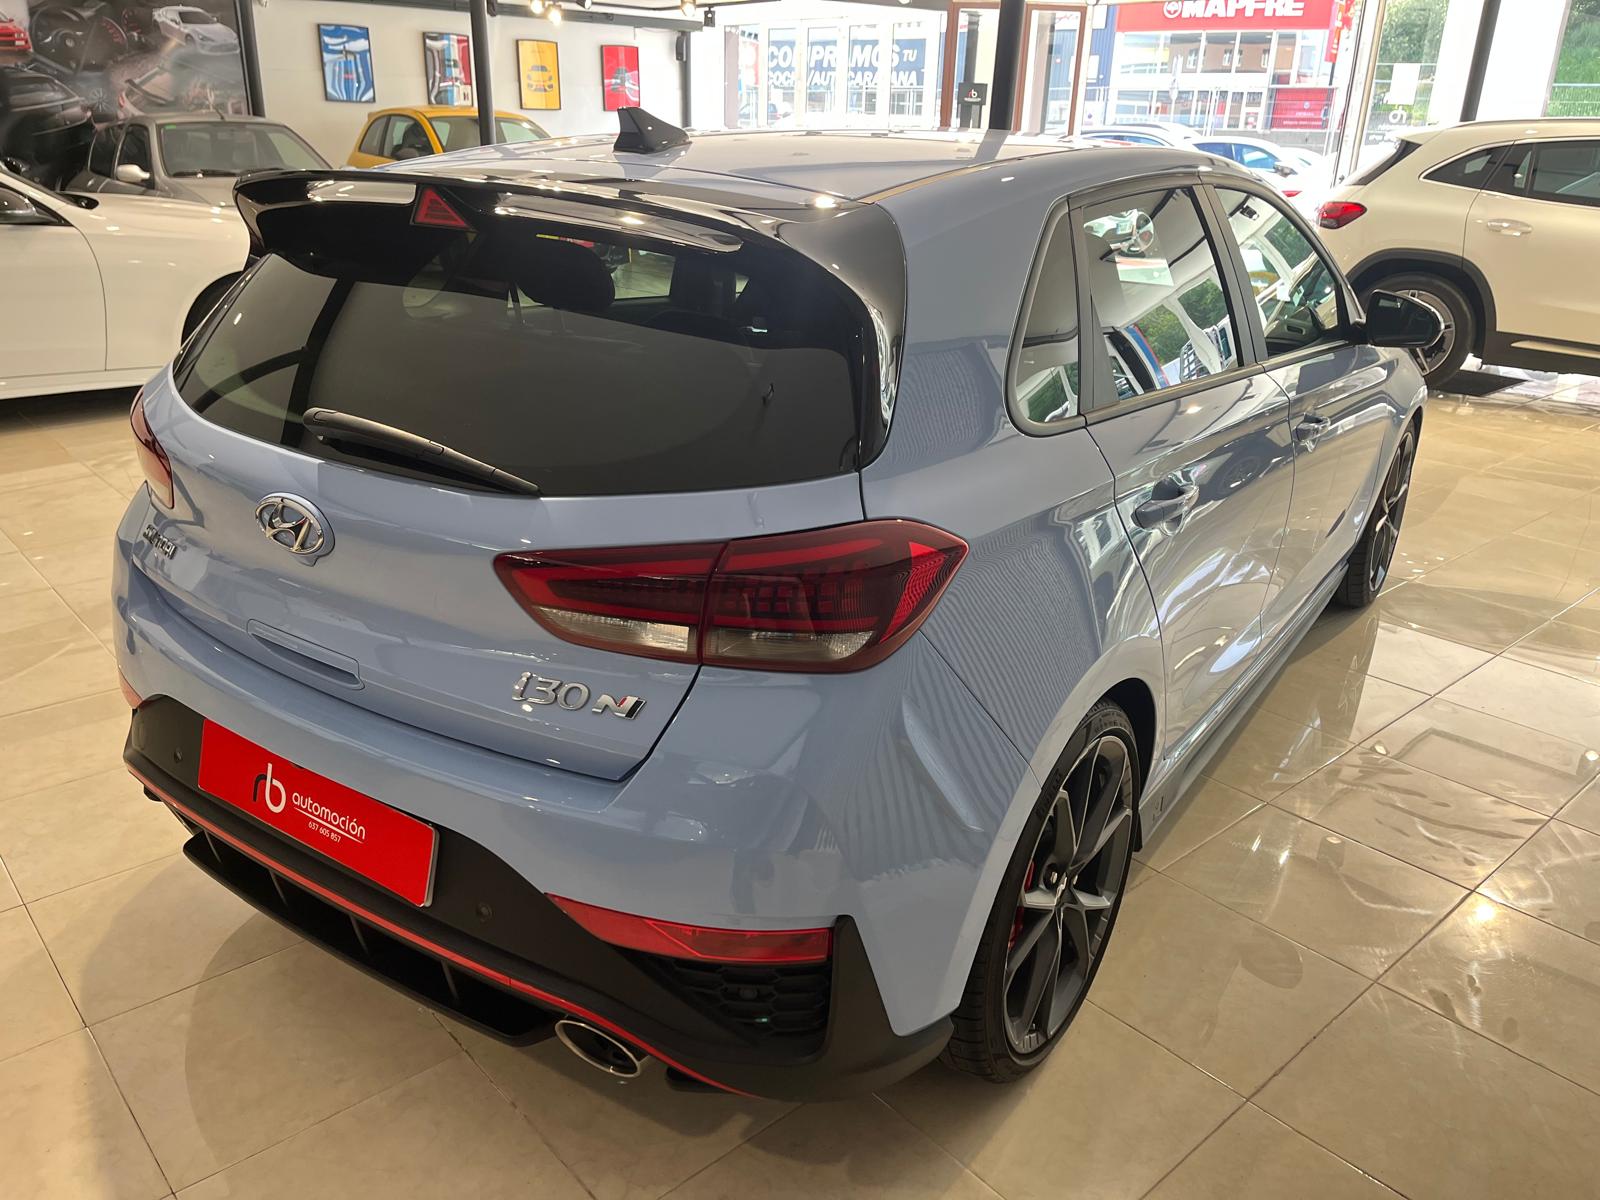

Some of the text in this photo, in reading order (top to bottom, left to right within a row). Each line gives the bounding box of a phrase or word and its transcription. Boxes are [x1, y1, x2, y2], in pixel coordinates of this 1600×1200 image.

[1182, 0, 1305, 18] MAPFRE
[768, 44, 918, 69] COPRMOS TU
[511, 671, 646, 720] i30 N
[253, 763, 286, 813] rb
[292, 792, 366, 839] automoción
[319, 827, 330, 838] 605
[330, 832, 341, 843] 857
